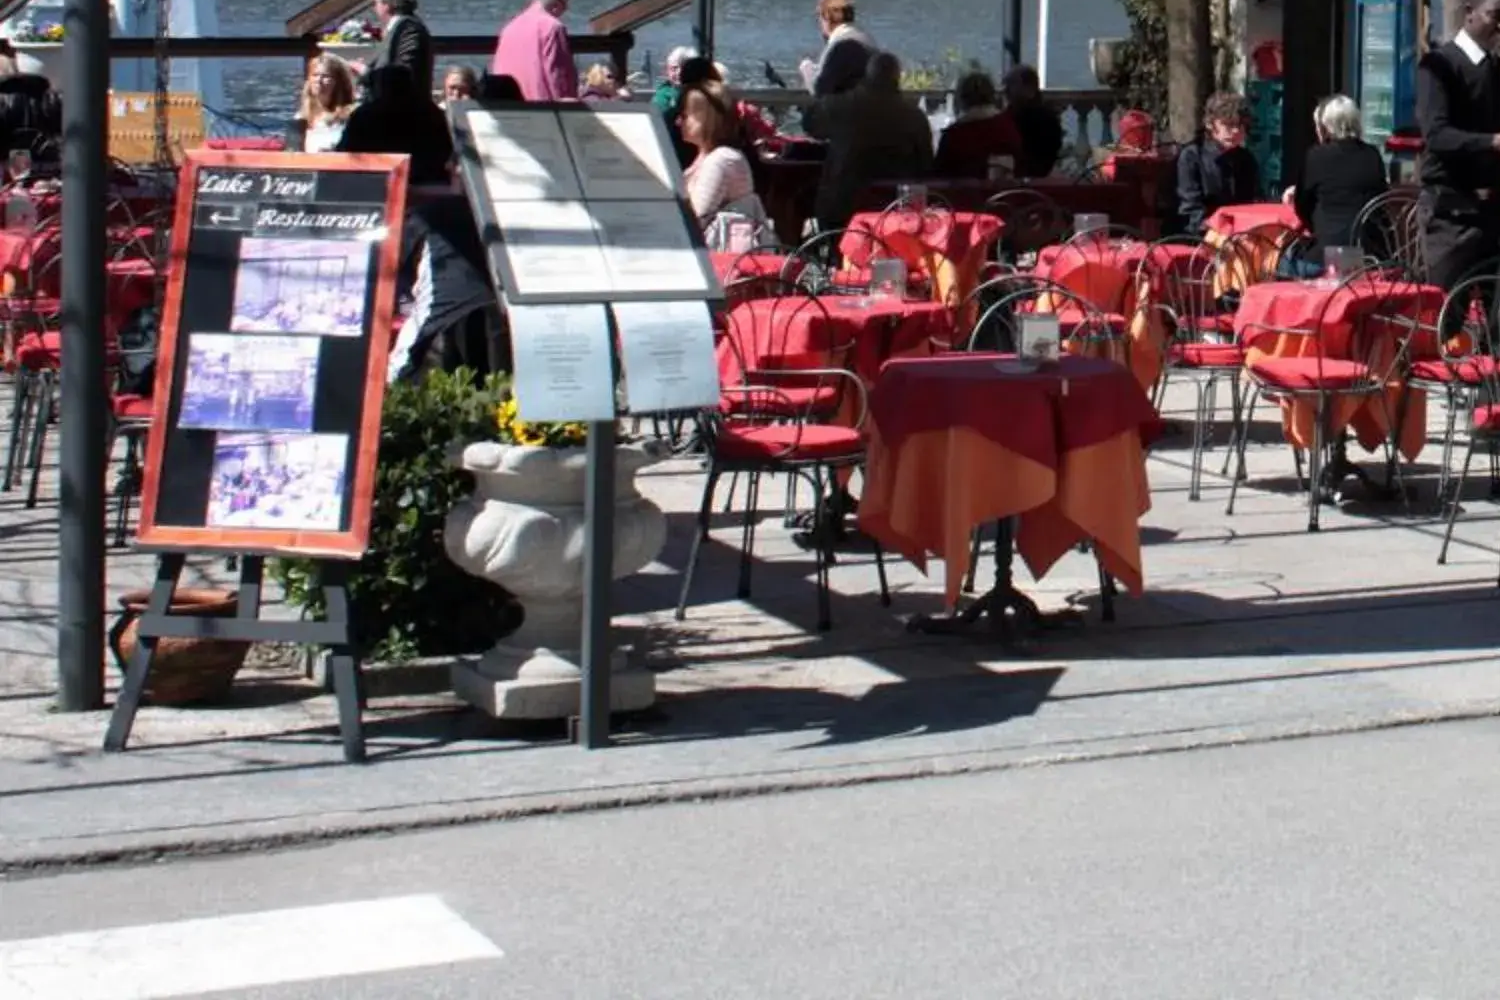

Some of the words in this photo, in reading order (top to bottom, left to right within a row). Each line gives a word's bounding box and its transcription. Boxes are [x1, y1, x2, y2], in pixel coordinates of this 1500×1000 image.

[198, 172, 253, 193] Lake
[260, 174, 314, 195] View
[257, 209, 380, 228] Restaurant
